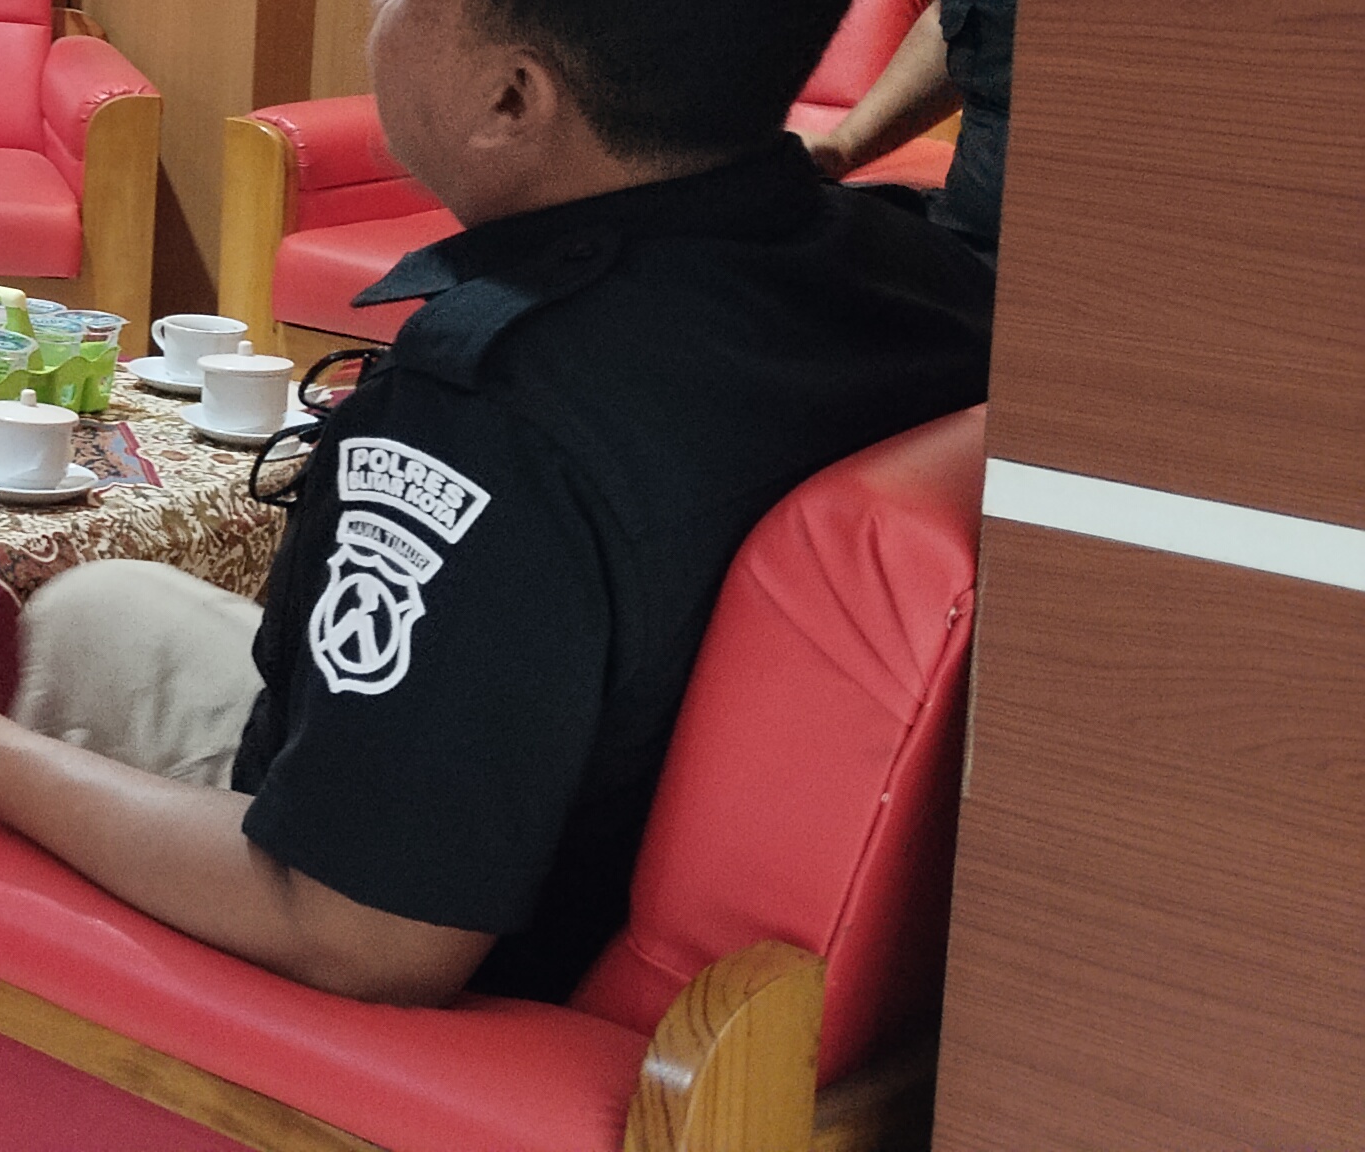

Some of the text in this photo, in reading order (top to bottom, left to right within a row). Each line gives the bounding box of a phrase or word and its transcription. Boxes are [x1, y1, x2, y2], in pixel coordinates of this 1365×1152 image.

[348, 470, 457, 529] BLITAR KOTA
[352, 448, 466, 509] POLRES
